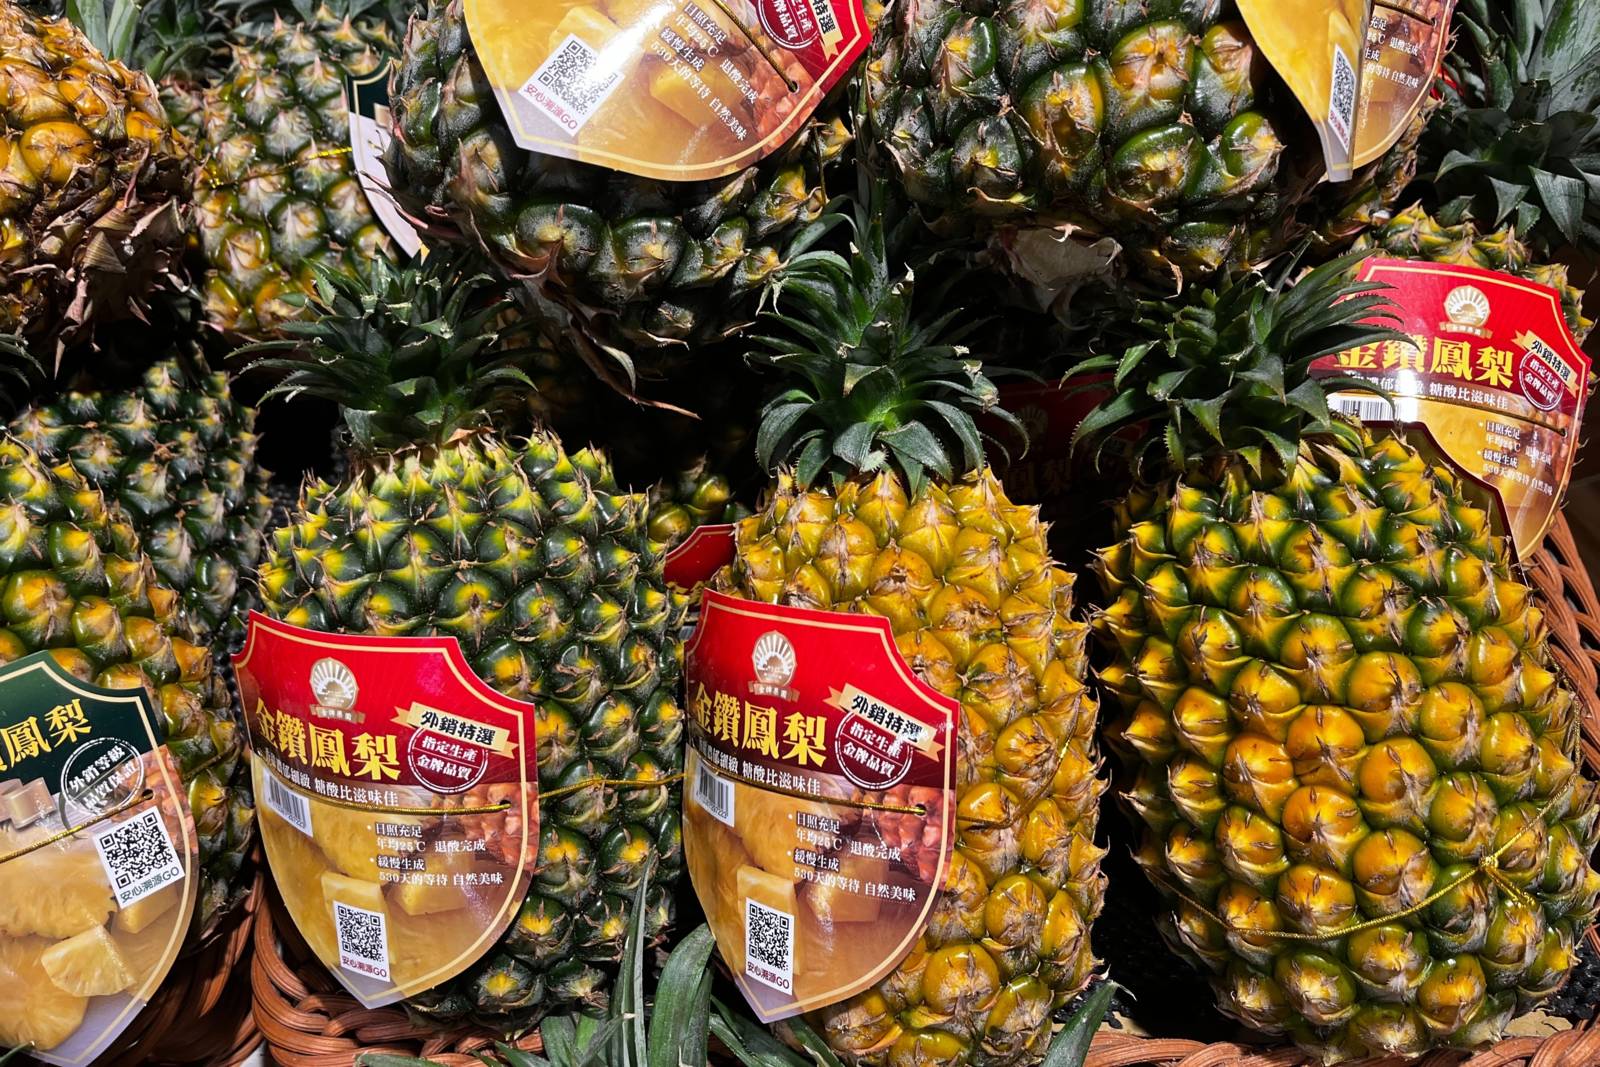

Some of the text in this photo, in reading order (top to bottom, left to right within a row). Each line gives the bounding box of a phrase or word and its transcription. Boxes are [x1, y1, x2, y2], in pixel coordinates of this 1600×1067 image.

[684, 2, 727, 45] 日照充足
[661, 27, 705, 72] 緩慢生成
[651, 41, 747, 141] 530天的等待 自然美味
[720, 58, 759, 104] 退酸完成
[1429, 382, 1508, 410] 糖酸比滋味佳
[0, 699, 92, 771] 鳳梨
[421, 711, 495, 745] 外銷特選
[696, 682, 827, 767] 金鑽鳳梨
[851, 695, 922, 742] 外銷特選
[256, 697, 401, 780] 金鑽鳳梨
[422, 736, 478, 762] 指定生產
[850, 721, 904, 758] 指定生產
[69, 745, 125, 792] 外銷等級
[417, 755, 472, 780] 金牌品質
[843, 742, 896, 778] 金牌品質
[314, 779, 399, 806] 糖酸比滋味佳
[742, 761, 820, 796] 糖酸比滋味佳
[376, 824, 422, 837] 日照充足
[797, 813, 840, 834] 日照充足
[377, 856, 425, 870] 緩慢生成
[435, 839, 486, 853] 退酸完成
[795, 849, 839, 872] 緩慢生成
[851, 841, 901, 861] 退酸完成
[379, 872, 503, 886] 530天的等待 自然美味
[794, 868, 916, 902] 530天的等待 自然美味
